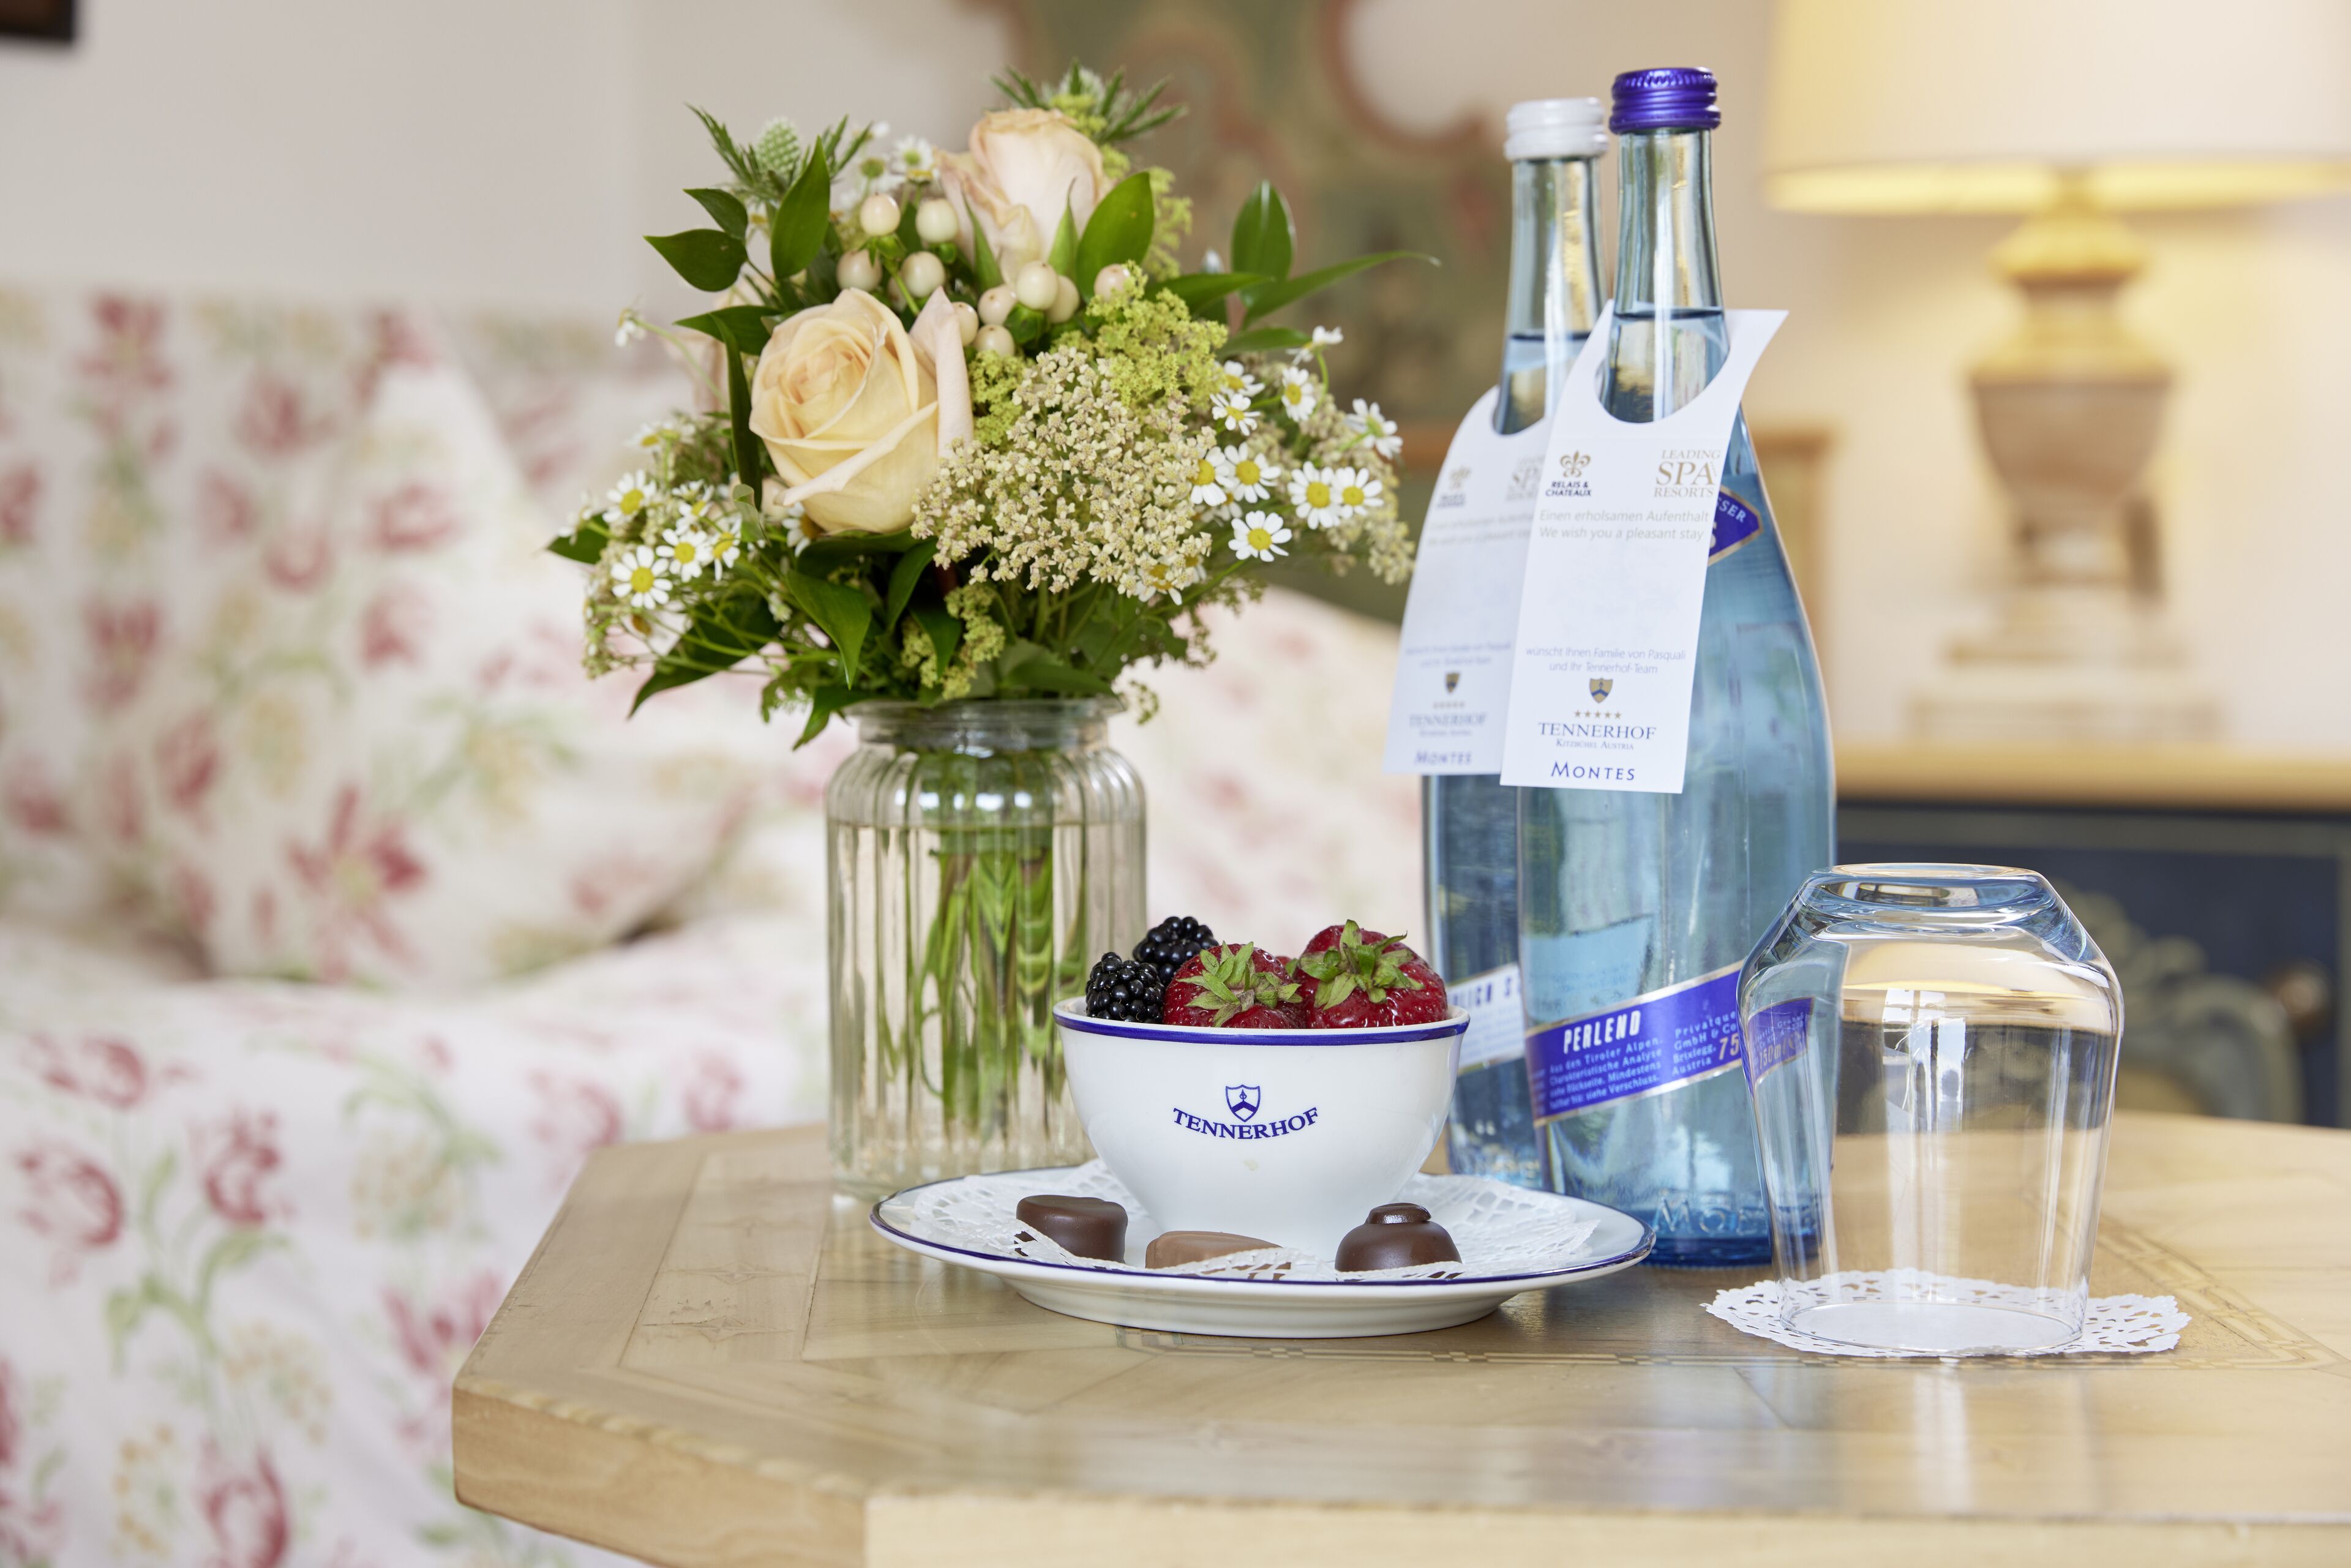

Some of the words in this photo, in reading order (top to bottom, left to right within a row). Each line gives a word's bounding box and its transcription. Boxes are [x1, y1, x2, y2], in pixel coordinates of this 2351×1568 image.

[1662, 449, 1721, 460] LEADING
[1655, 461, 1715, 486] SPA
[1654, 487, 1714, 498] RESORTS
[1540, 509, 1571, 522] Einen
[1574, 509, 1643, 522] erholsamen
[1646, 509, 1709, 523] Aufenthalt
[1539, 527, 1558, 538] We
[1561, 527, 1587, 538] wish
[1591, 528, 1613, 542] you
[1615, 530, 1622, 539] a
[1625, 527, 1676, 541] pleasant
[1679, 529, 1704, 542] stay
[1565, 647, 1591, 658] Ihnen
[1594, 648, 1625, 659] Familie
[1628, 650, 1646, 659] von
[1648, 649, 1686, 662] Pasquali
[1549, 661, 1568, 672] und
[1570, 662, 1583, 672] Ihr
[1538, 722, 1657, 740] TENNERHOF
[1550, 760, 1635, 781] MONTES
[1563, 1010, 1641, 1055] PERLEND
[1674, 1032, 1708, 1051] GmbH
[1584, 1048, 1621, 1065] Tiroler
[1622, 1049, 1662, 1067] Analyse
[1607, 1060, 1662, 1083] Mindestens
[1672, 1057, 1712, 1076] Austria
[1173, 1107, 1318, 1139] TENNERHOF
